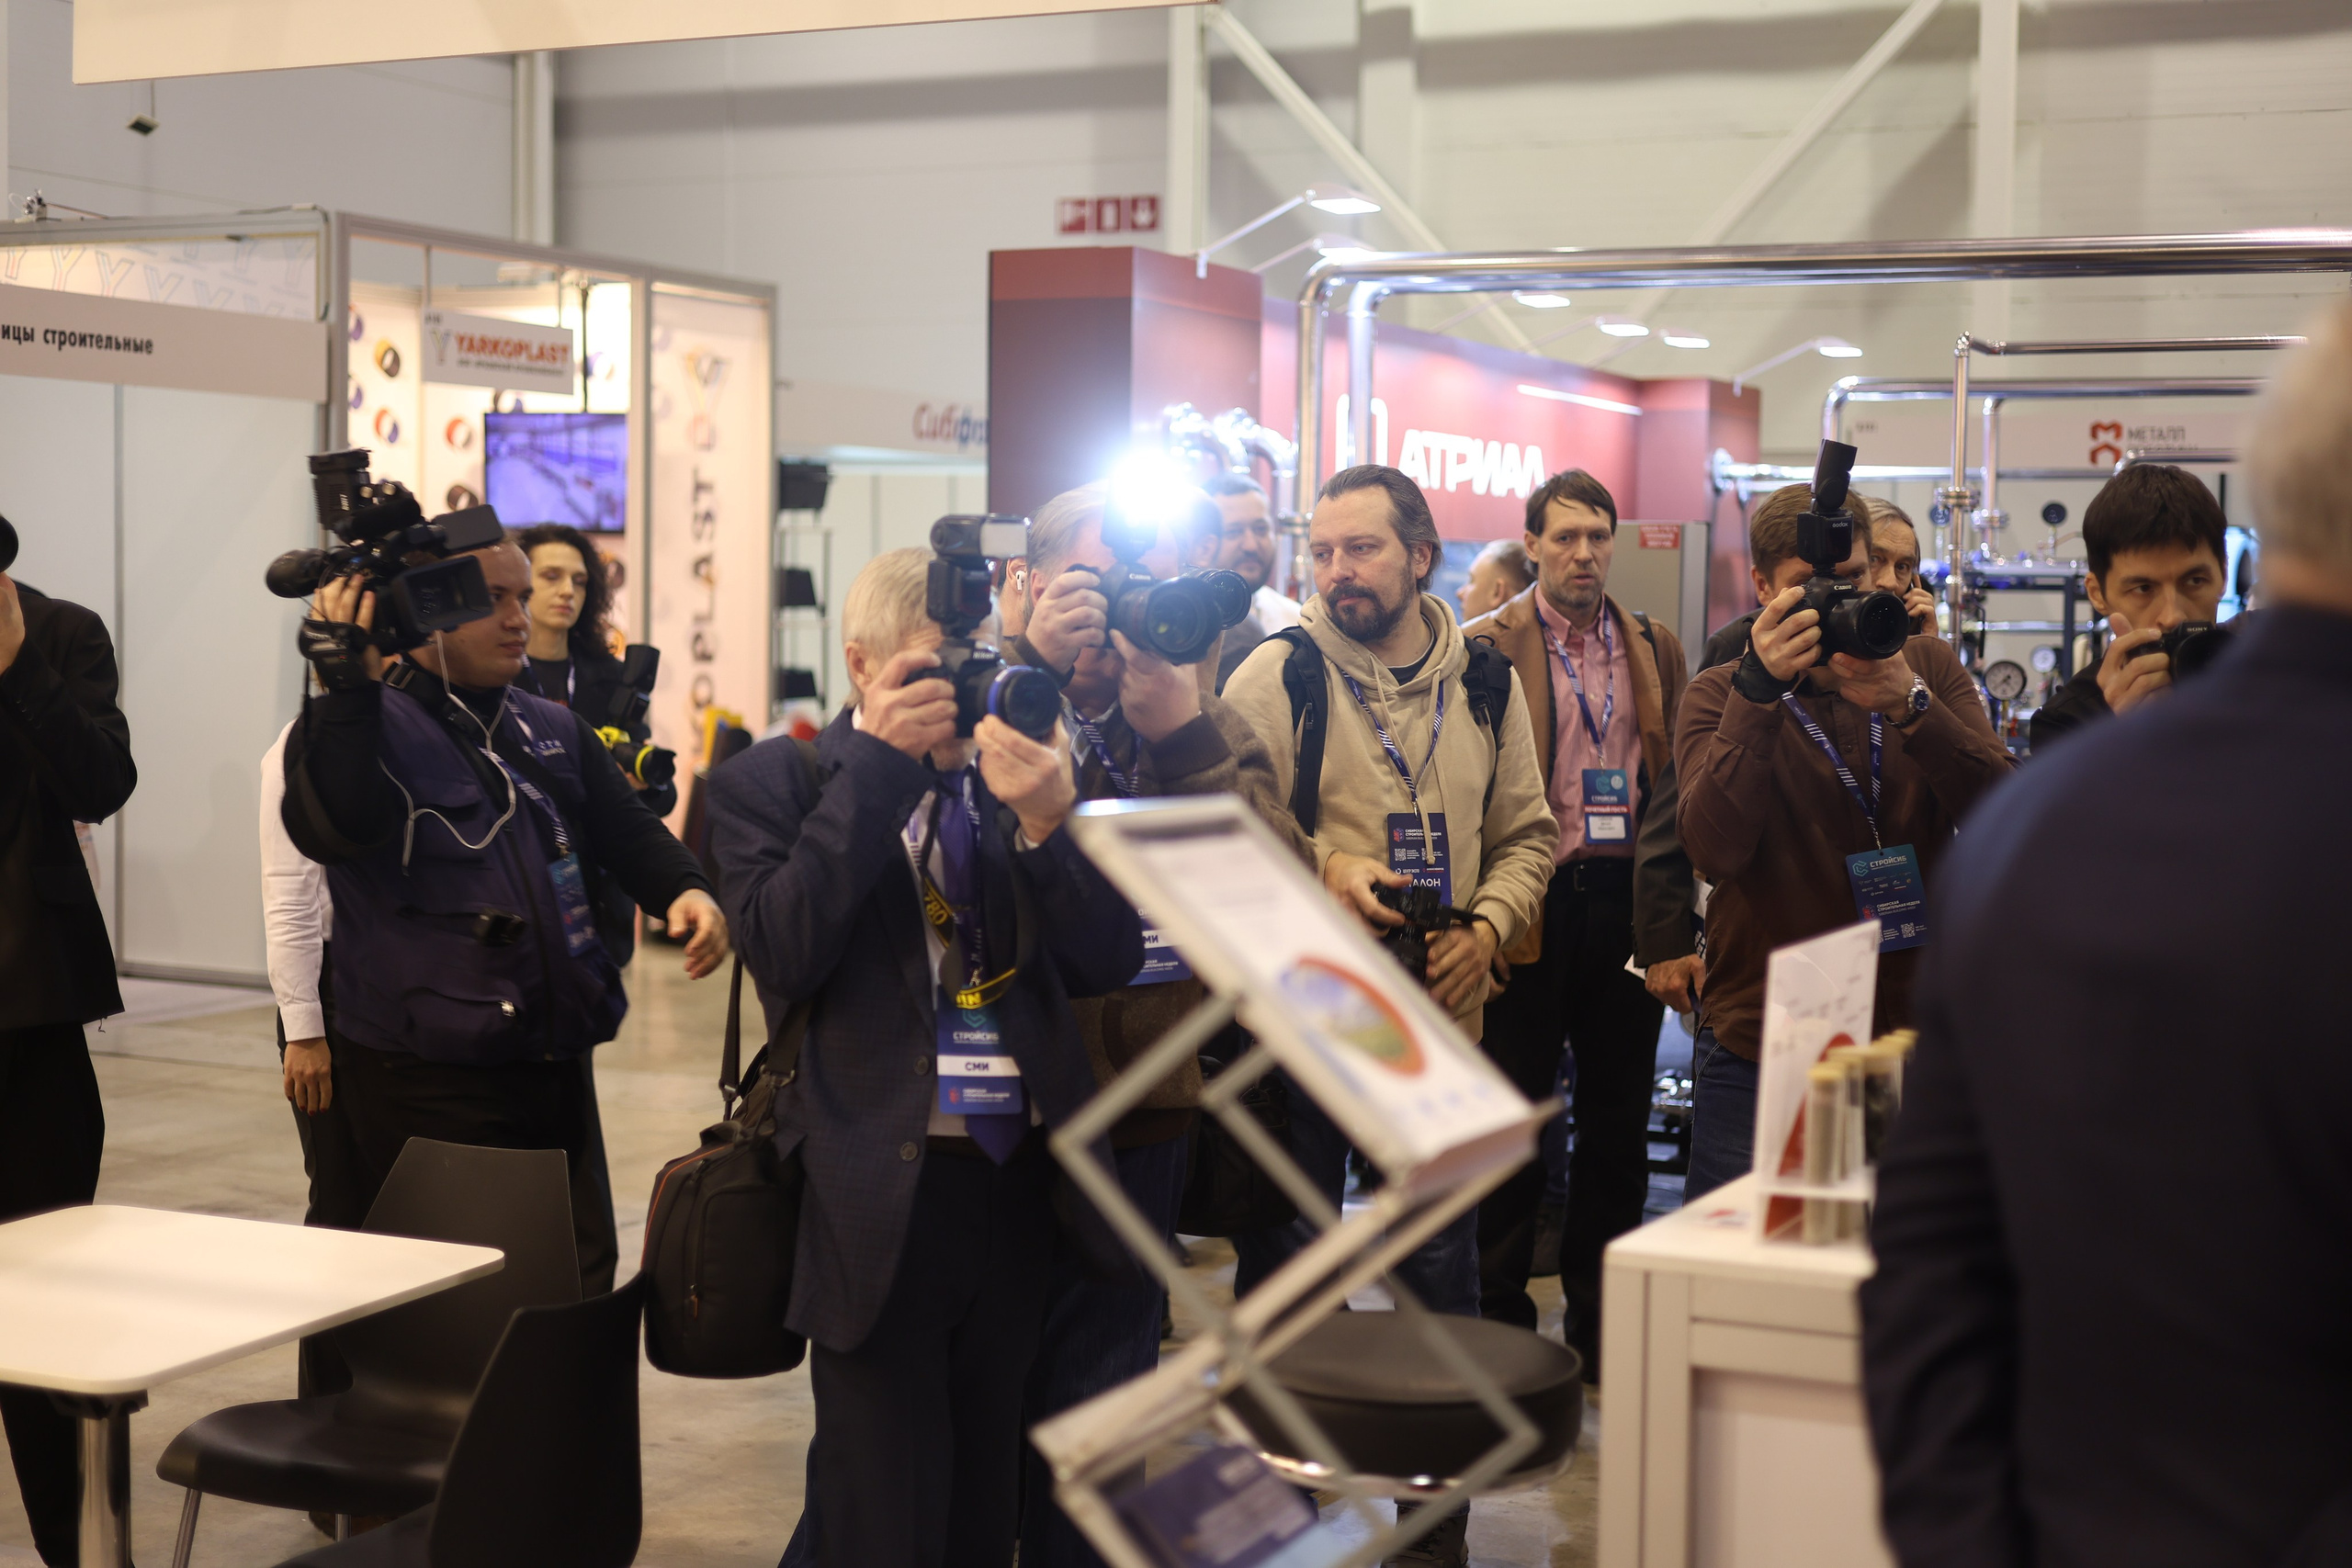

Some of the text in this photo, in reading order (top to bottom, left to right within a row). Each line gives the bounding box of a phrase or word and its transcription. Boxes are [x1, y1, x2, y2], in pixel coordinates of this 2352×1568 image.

[43, 328, 154, 355] строительные
[456, 332, 570, 365] YARKOPLAST
[2127, 425, 2186, 441] МЕТАЛЛ
[1397, 429, 1546, 500] АТРИАЛ
[1128, 573, 1151, 581] Canon
[973, 651, 995, 660] Nikon
[1870, 855, 1907, 868] СТРОЙСИБ
[1408, 878, 1441, 887] АЛОН
[953, 1030, 1000, 1041] СТРОЙСИБ
[965, 1062, 989, 1072] СМИ
